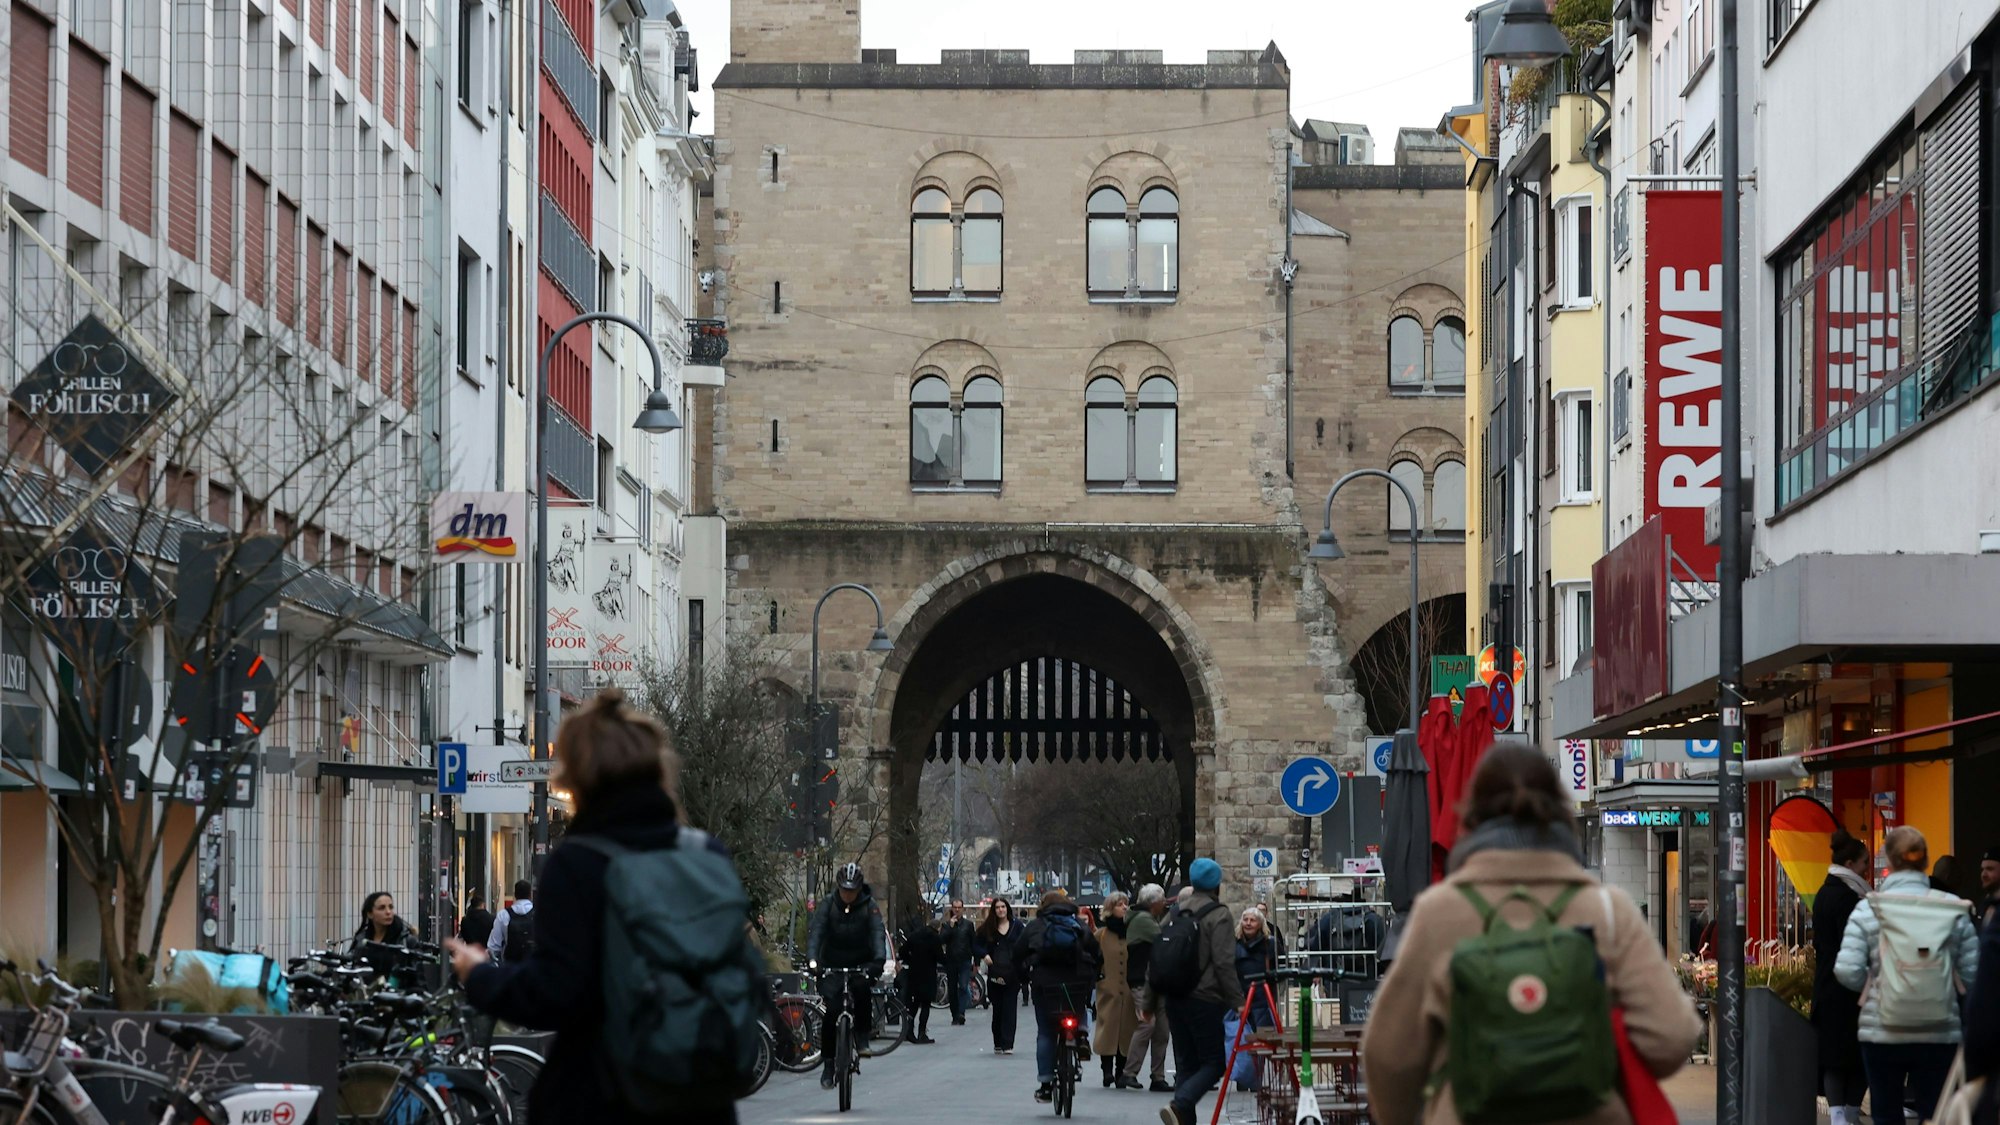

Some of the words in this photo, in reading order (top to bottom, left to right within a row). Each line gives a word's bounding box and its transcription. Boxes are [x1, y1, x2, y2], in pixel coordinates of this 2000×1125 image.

[1658, 264, 1723, 508] REWE
[449, 503, 508, 538] dm
[60, 581, 122, 595] RILLEN
[593, 660, 632, 672] BOOR
[1439, 660, 1469, 677] THAI
[1481, 660, 1523, 672] KIK
[445, 749, 461, 788] P
[242, 1108, 272, 1125] KVB
